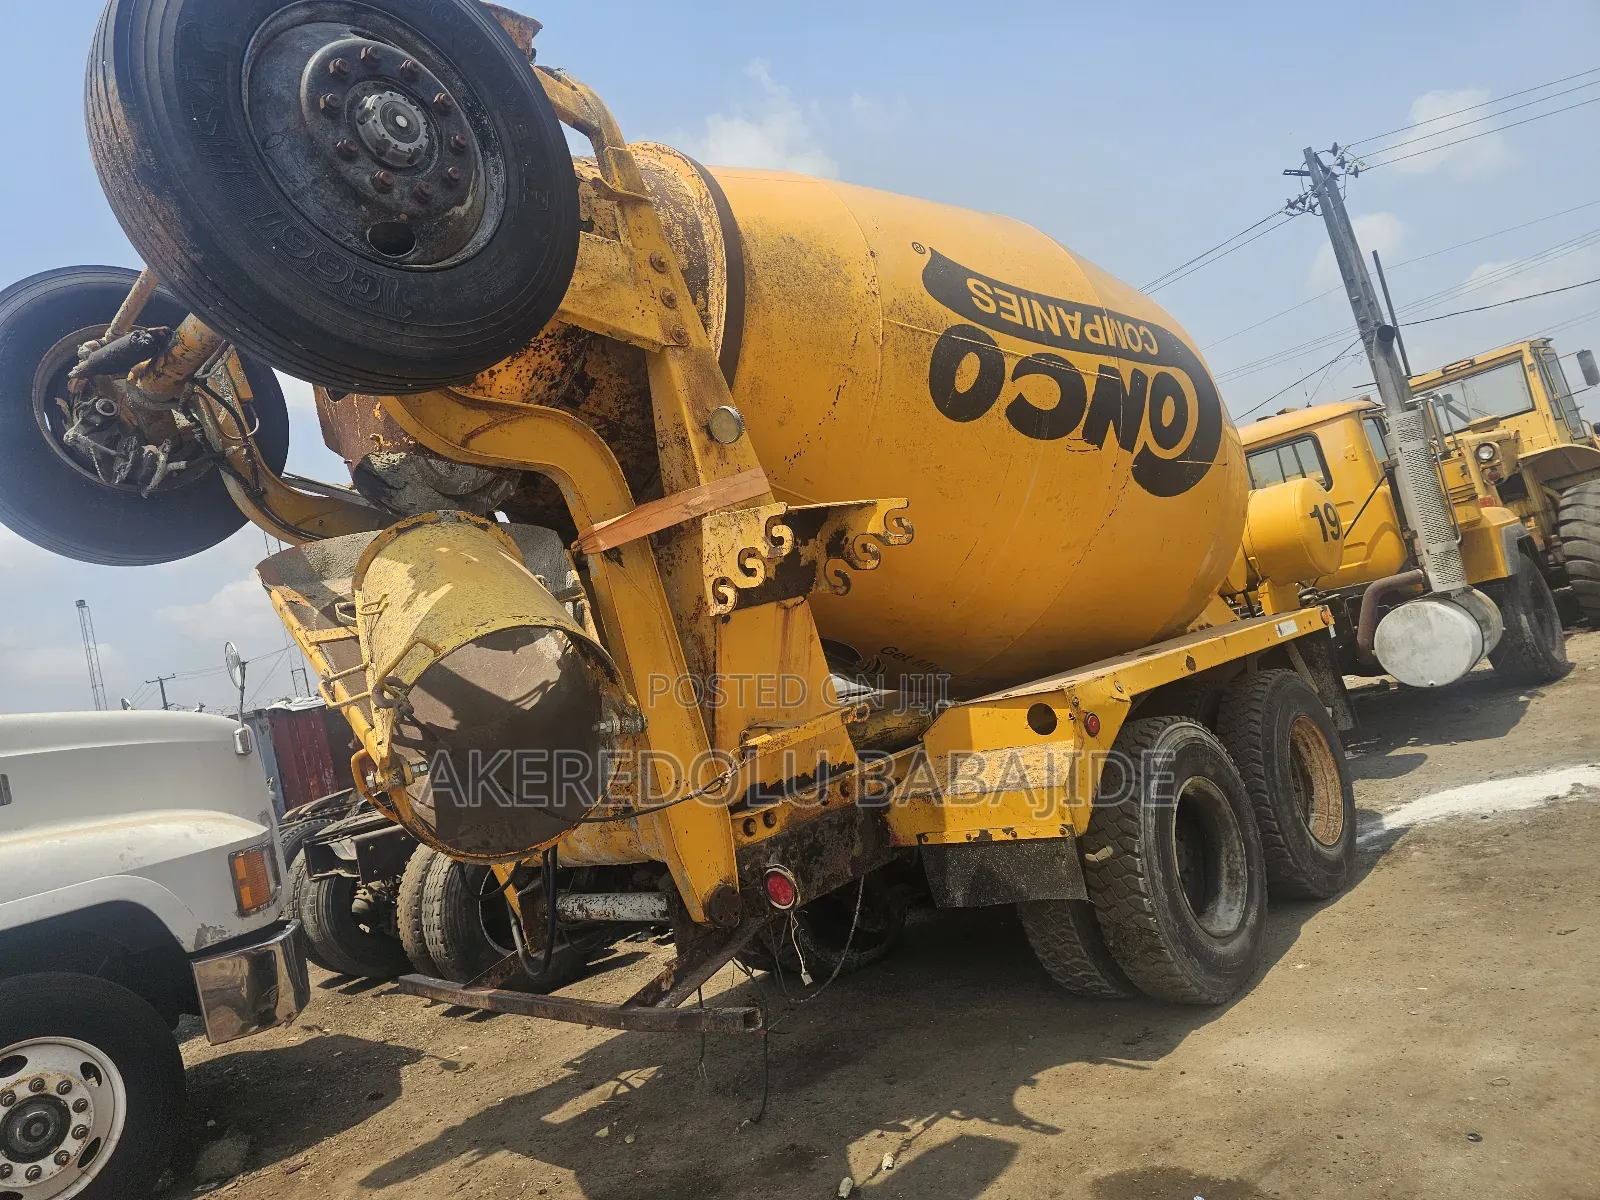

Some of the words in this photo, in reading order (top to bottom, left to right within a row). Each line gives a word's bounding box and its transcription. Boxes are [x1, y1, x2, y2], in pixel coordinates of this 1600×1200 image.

[252, 210, 381, 302] G661
[966, 278, 1159, 355] COMPANIES
[928, 323, 1222, 497] CONCO
[1309, 502, 1341, 543] 19
[880, 645, 915, 663] Get
